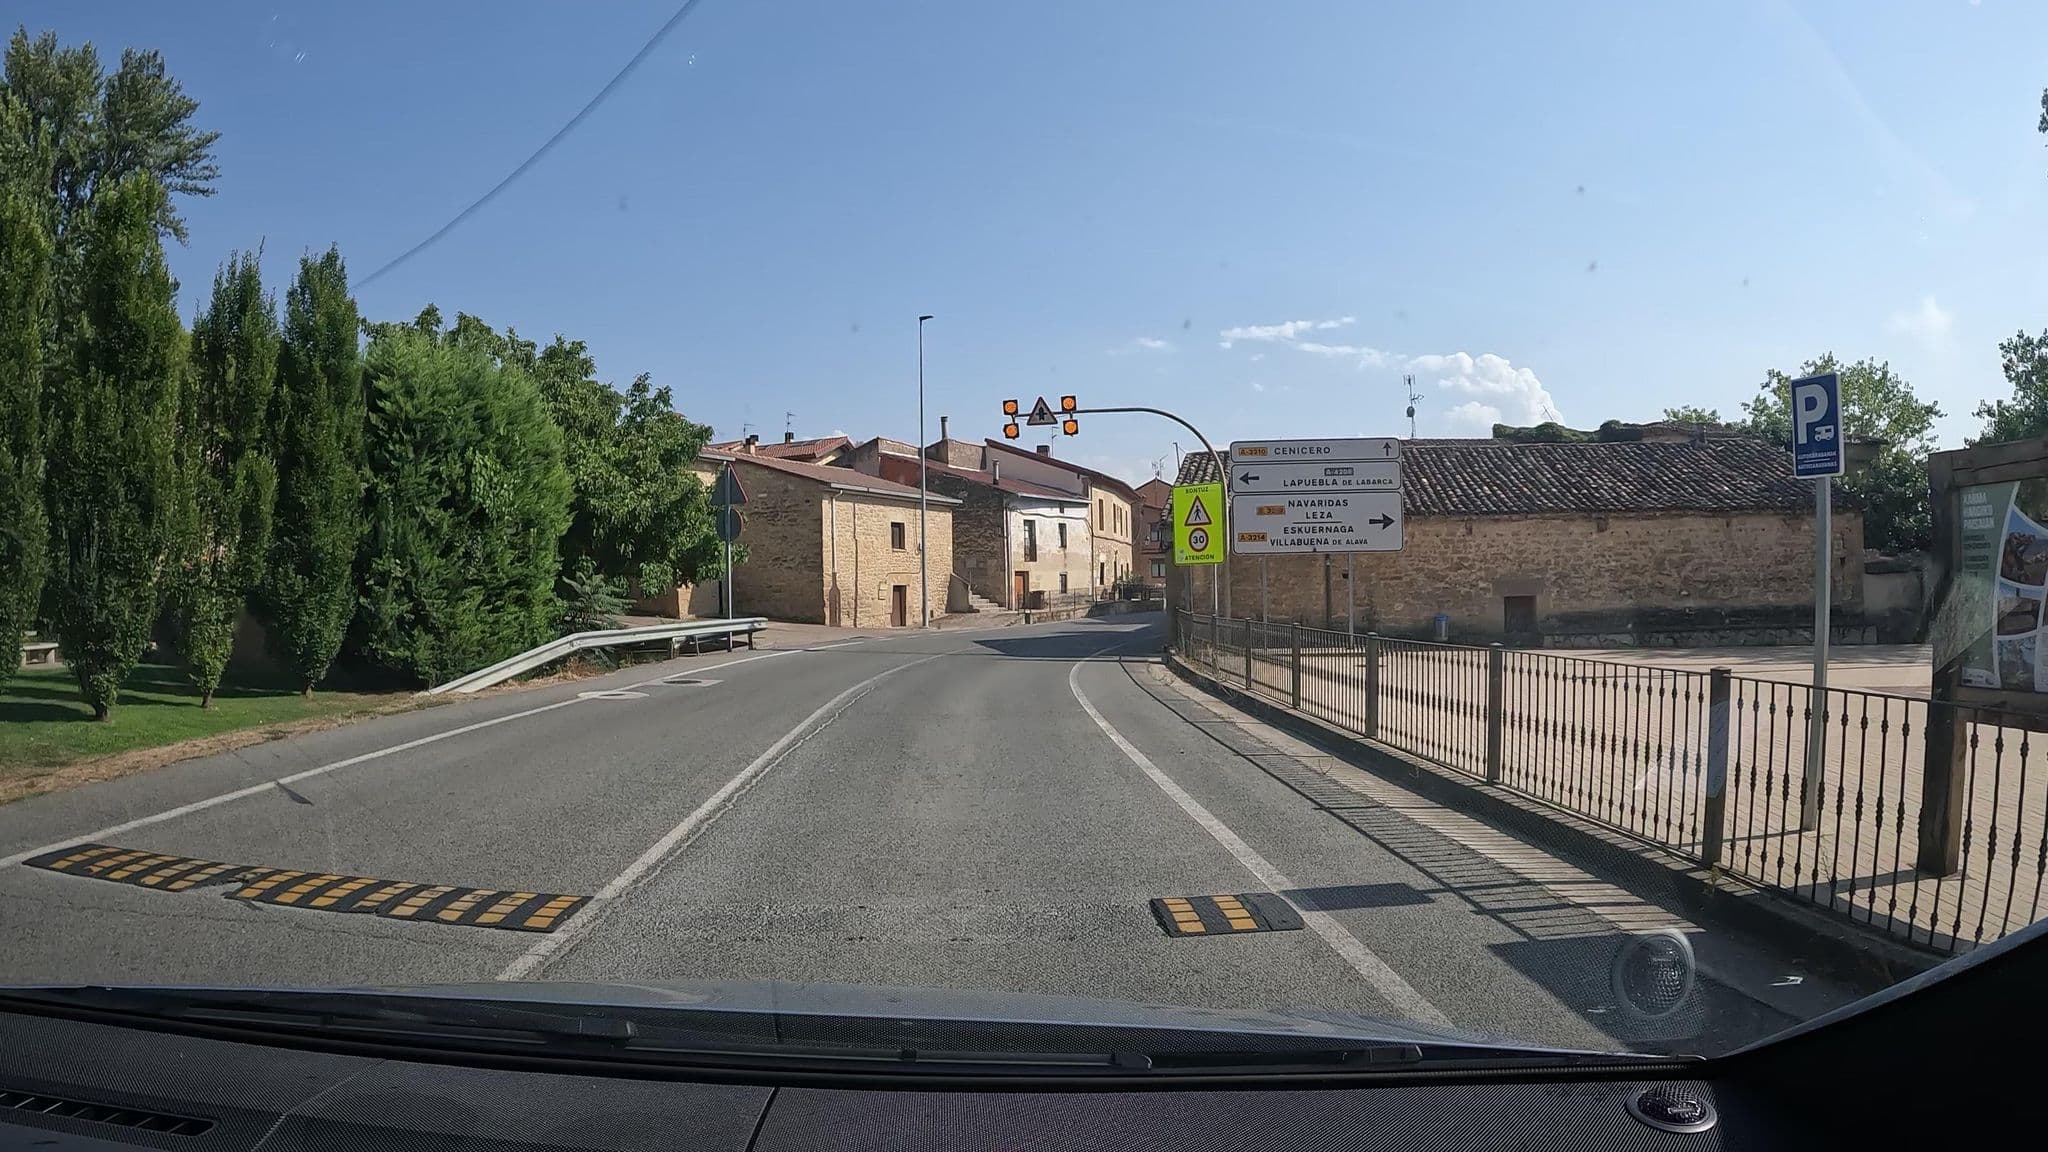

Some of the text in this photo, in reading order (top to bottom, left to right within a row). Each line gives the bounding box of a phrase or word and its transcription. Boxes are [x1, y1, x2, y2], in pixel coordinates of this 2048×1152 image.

[1795, 384, 1828, 444] P
[1274, 447, 1331, 455] CENICERO
[1283, 478, 1338, 487] LAPUEBLA
[1356, 478, 1393, 486] LABARCA
[1288, 499, 1349, 507] NAVARIDAS
[1305, 511, 1333, 519] LEZA
[1283, 526, 1354, 535] ESKUERNAGA
[1192, 535, 1205, 544] 30
[1270, 538, 1329, 547] VILLABUENA
